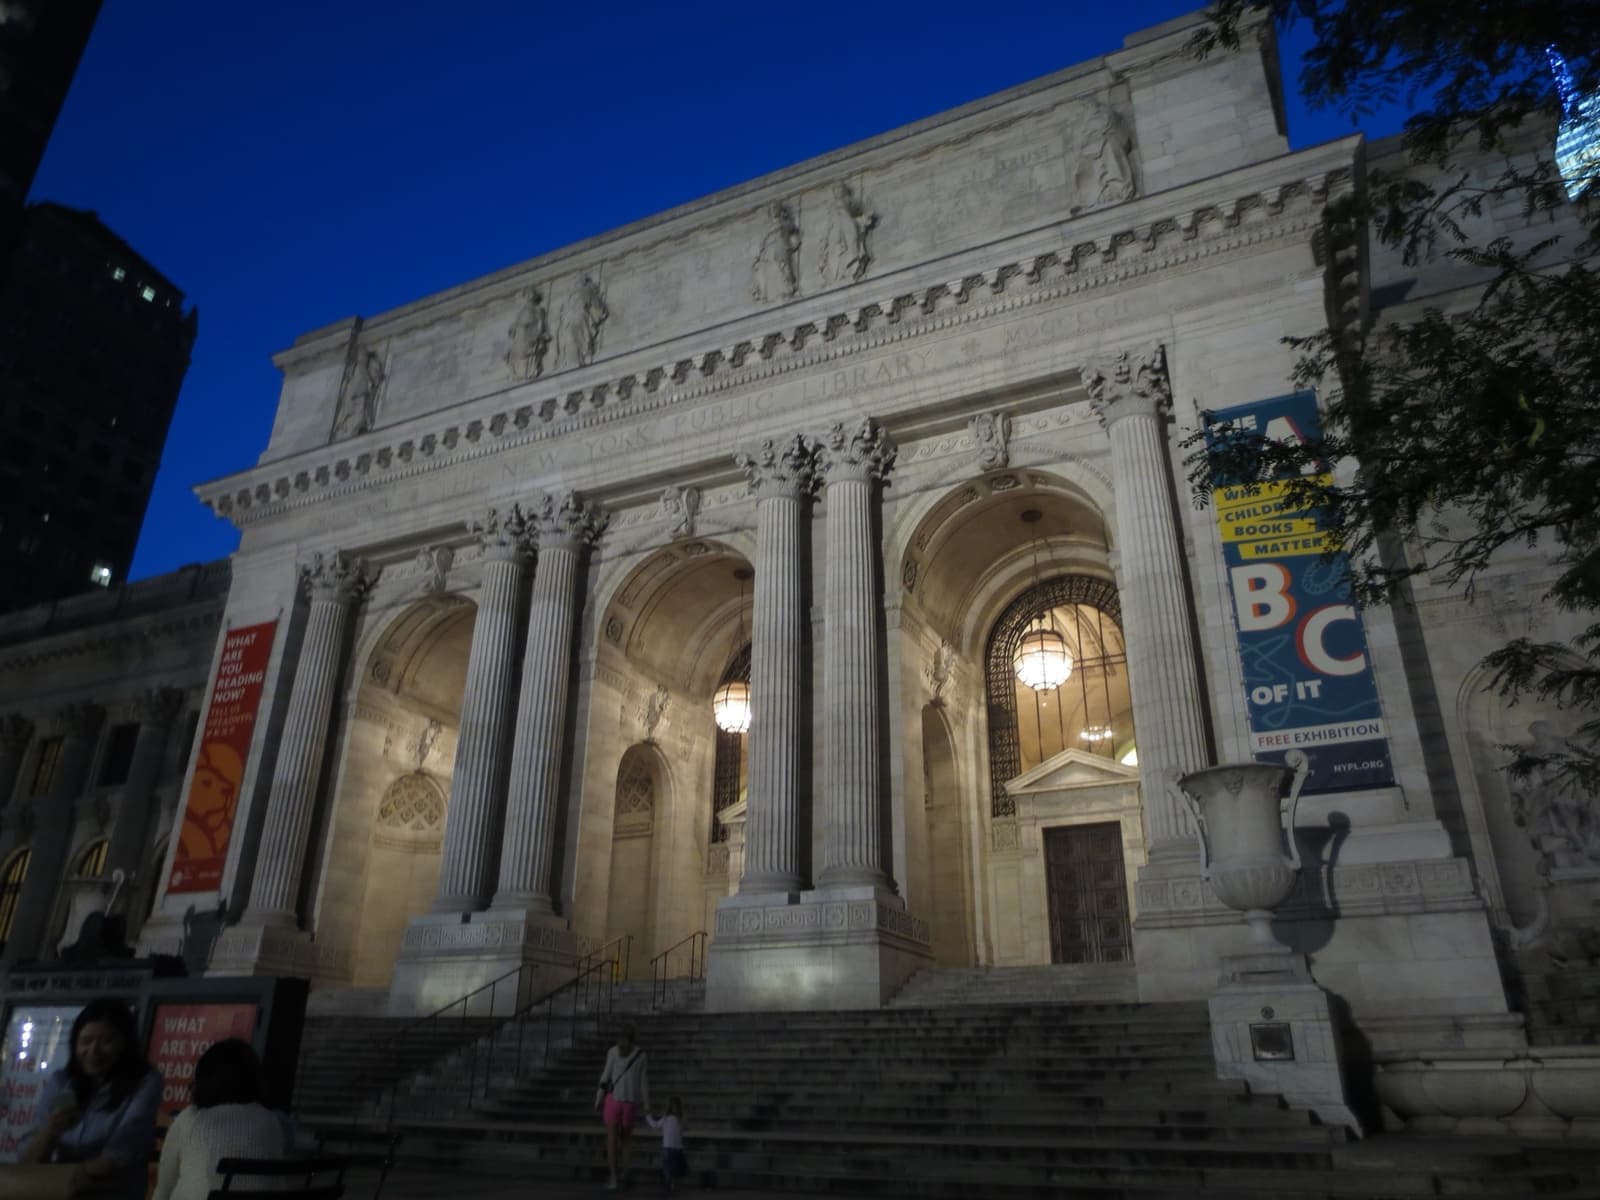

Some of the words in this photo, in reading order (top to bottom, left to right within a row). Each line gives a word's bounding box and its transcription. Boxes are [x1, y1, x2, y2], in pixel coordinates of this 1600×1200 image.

[501, 448, 562, 482] NEW
[584, 421, 650, 461] YORK
[672, 388, 776, 436] PUBLIC
[800, 345, 936, 402] LIBRARY
[1233, 522, 1294, 537] BOOKS
[1254, 536, 1322, 555] MATTER
[1231, 562, 1297, 632] B
[227, 632, 258, 649] WHAT
[1296, 603, 1367, 676] C
[223, 649, 244, 663] ARE
[221, 662, 244, 677] YOU
[216, 670, 265, 690] READING
[212, 688, 247, 705] NOW?
[1251, 684, 1289, 706] OF
[1296, 679, 1322, 701] IT
[1257, 735, 1291, 748] FREE
[1294, 723, 1381, 745] EXHIBITION
[1333, 760, 1385, 774] NYPL.ORG
[164, 1016, 208, 1033] WHAT
[160, 1040, 187, 1057] ARE
[190, 1039, 216, 1057] YO
